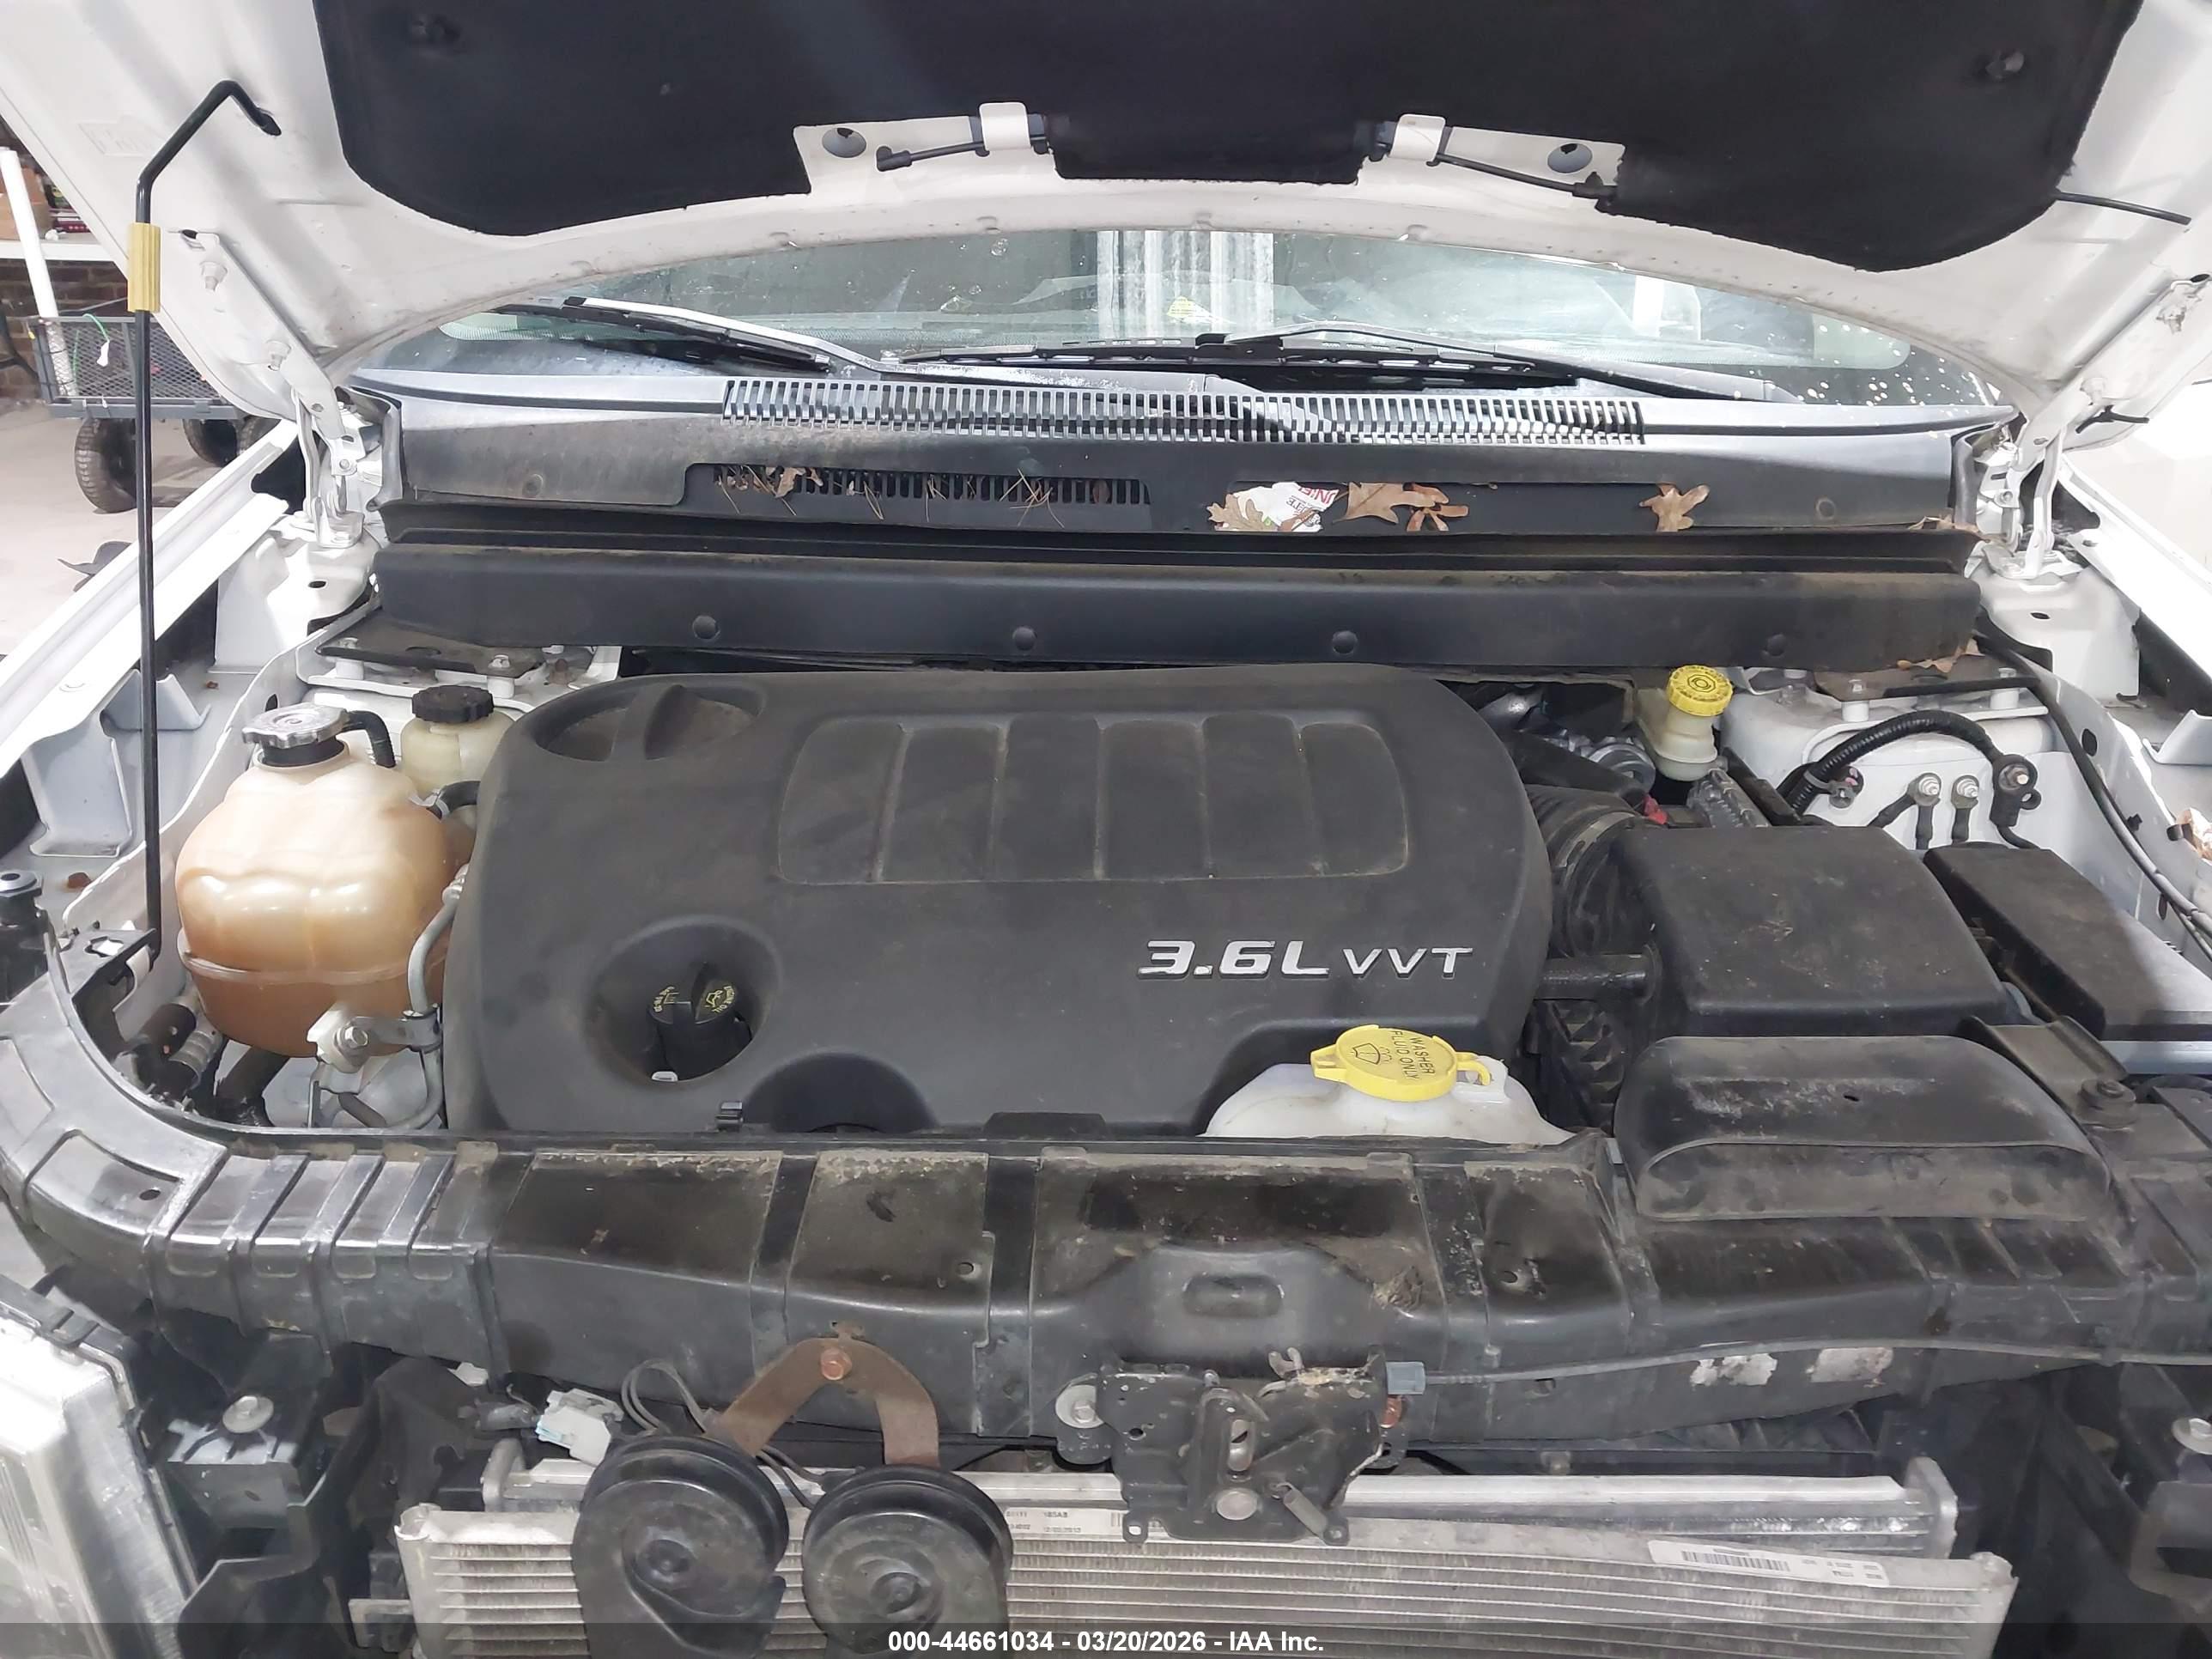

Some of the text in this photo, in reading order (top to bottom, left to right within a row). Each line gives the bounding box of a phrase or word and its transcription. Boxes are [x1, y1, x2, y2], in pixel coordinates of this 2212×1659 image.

[1138, 940, 1474, 979] 3.6L VVT
[1391, 1030, 1420, 1079] FLUID ONLY
[1409, 1036, 1436, 1074] WASHER
